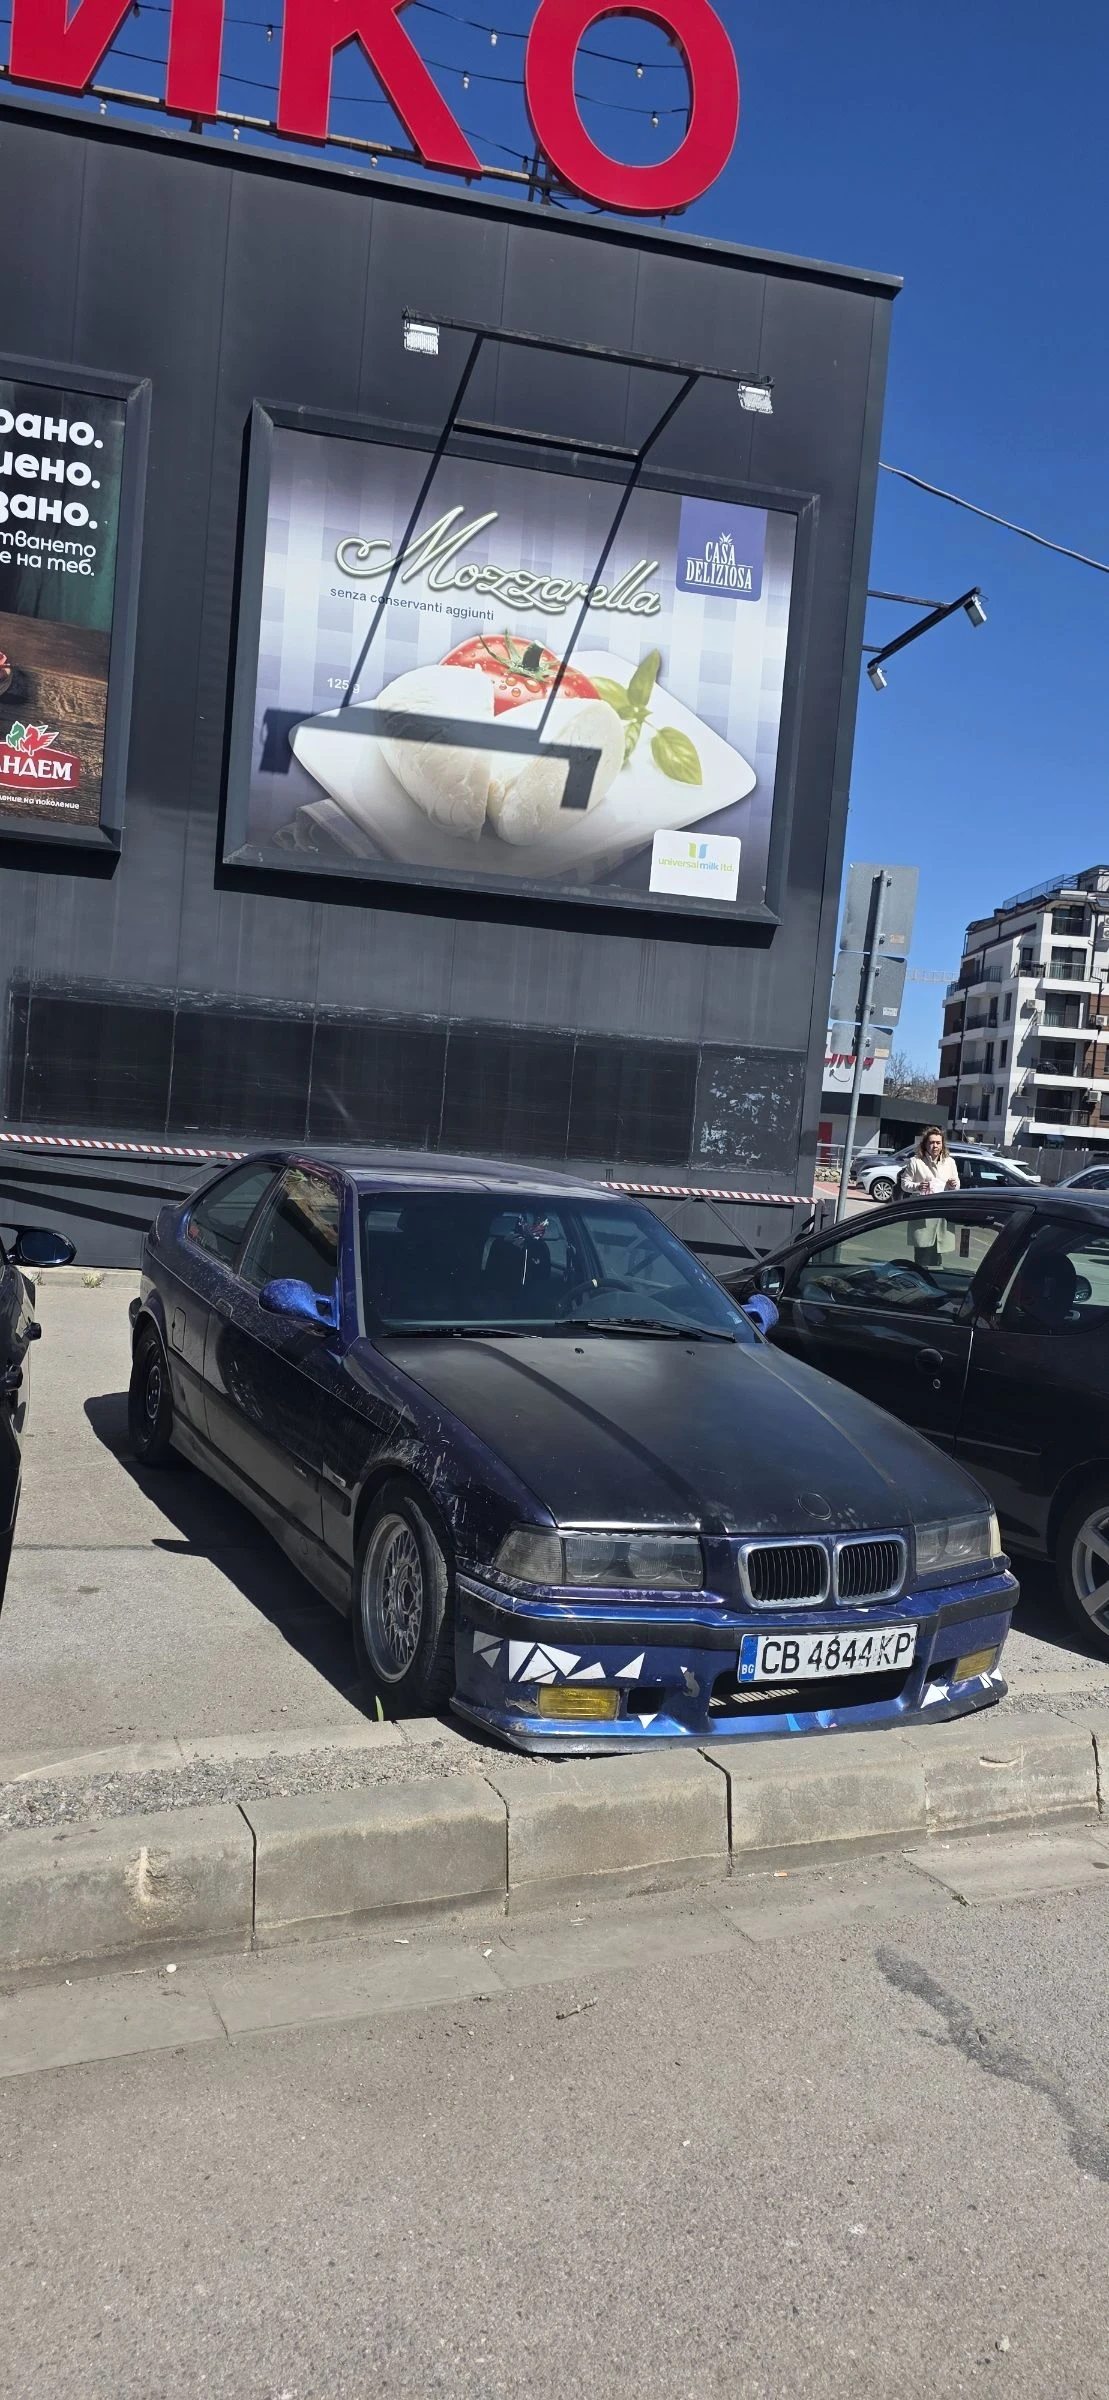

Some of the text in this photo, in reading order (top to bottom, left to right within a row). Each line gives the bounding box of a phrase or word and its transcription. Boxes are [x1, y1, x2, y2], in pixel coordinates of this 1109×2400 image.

[16, 552, 42, 569] на
[47, 557, 95, 577] теб.
[336, 505, 662, 616] Mozzarella
[705, 541, 736, 566] CASA
[685, 559, 753, 590] DELIZIOSA
[330, 587, 495, 621] senza conservanti aggiunti
[327, 677, 350, 690] 125
[0, 755, 73, 781] НДЕМ
[0, 794, 23, 802] ение
[35, 799, 80, 810] поколение
[658, 857, 699, 869] universal
[699, 860, 719, 871] milk
[741, 1663, 755, 1674] BG
[761, 1640, 800, 1674] CB
